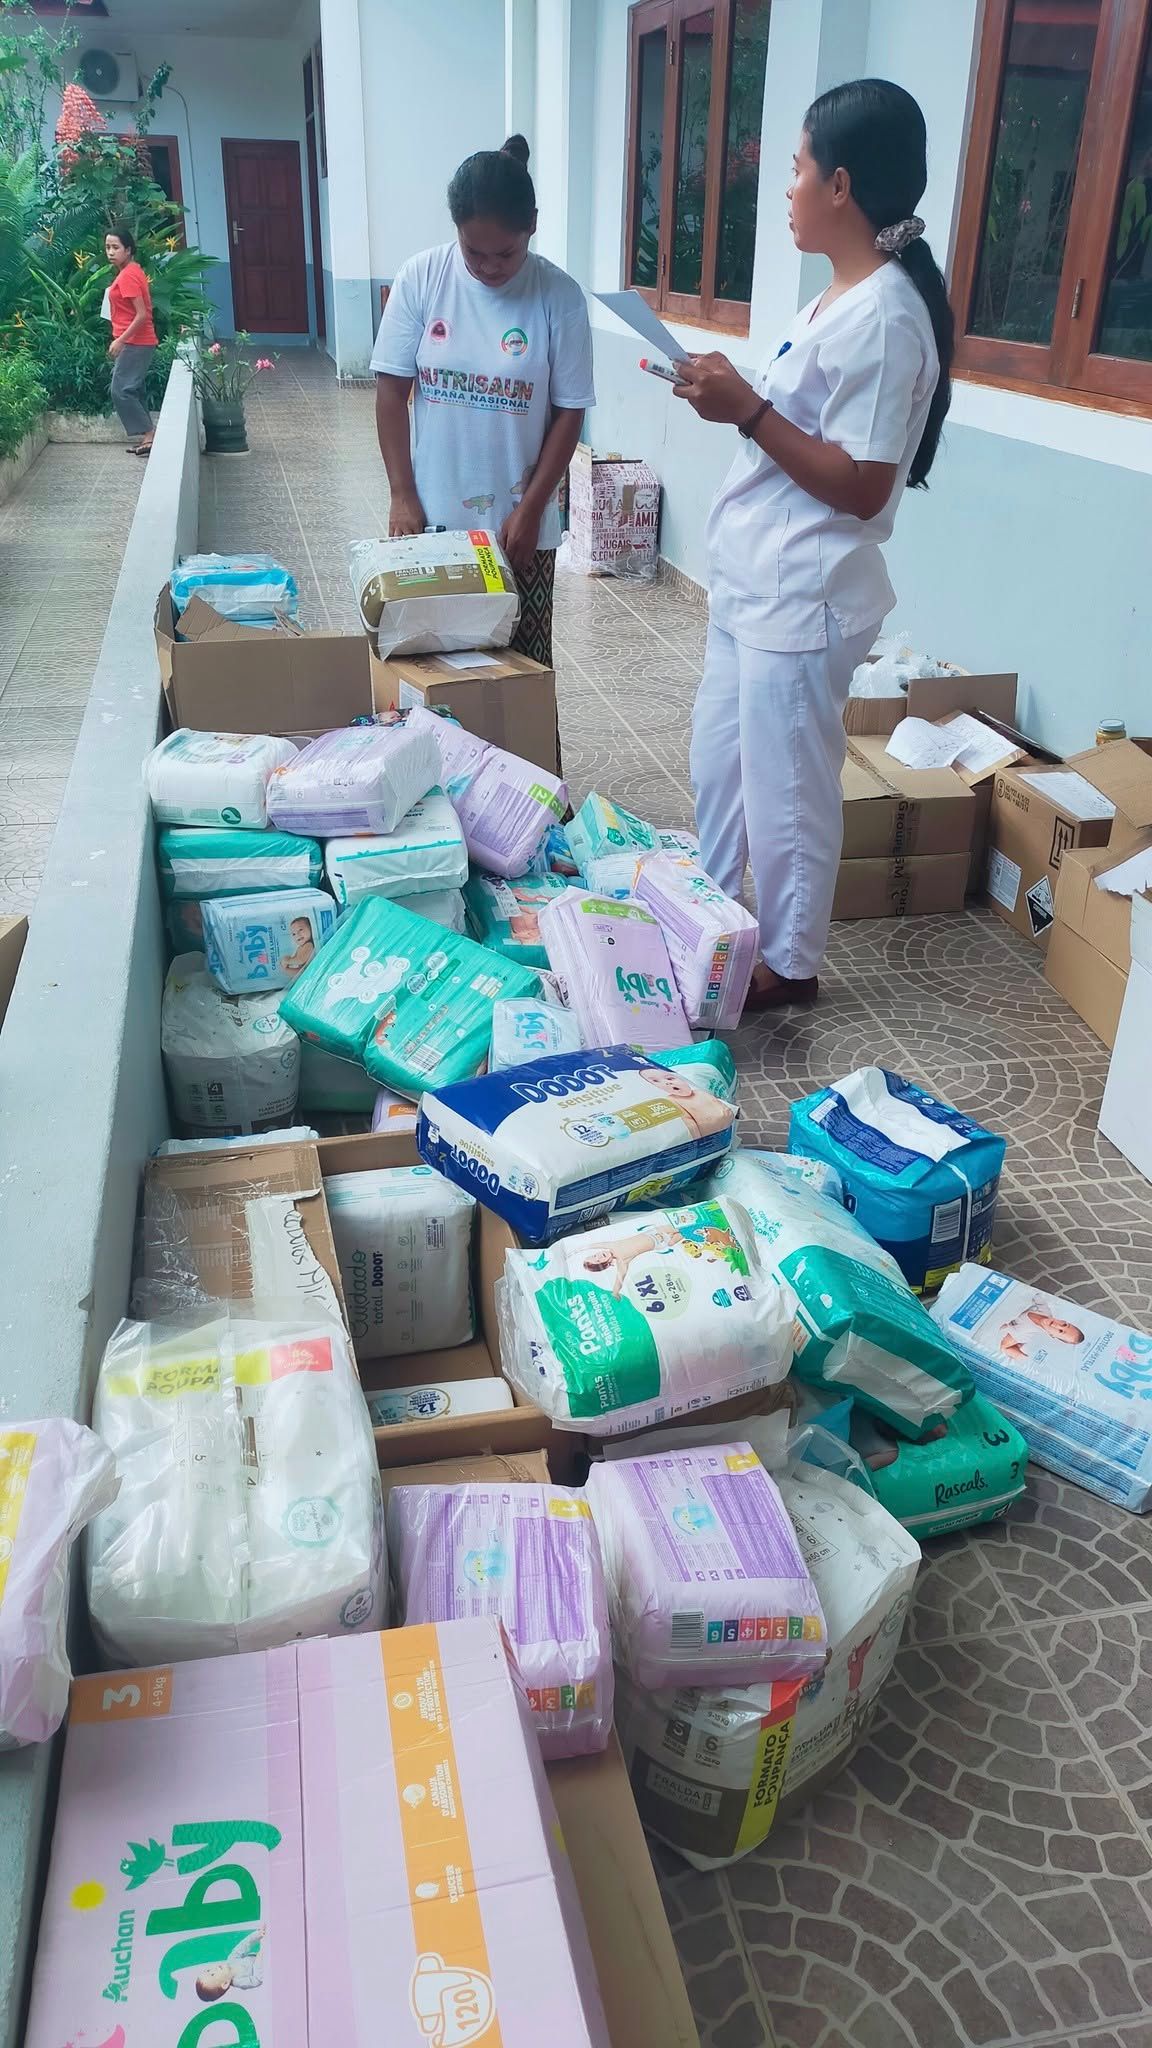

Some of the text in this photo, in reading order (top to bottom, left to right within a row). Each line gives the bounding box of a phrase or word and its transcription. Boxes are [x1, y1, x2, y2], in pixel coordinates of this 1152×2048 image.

[420, 367, 534, 400] NUTRISAUN
[616, 966, 673, 1002] baby
[510, 1063, 618, 1103] DODOT
[557, 1083, 622, 1109] sensitive
[573, 1125, 591, 1137] 12
[458, 1139, 495, 1168] sensitive
[450, 1144, 500, 1196] DODOT
[372, 1251, 384, 1287] DODOT
[567, 1295, 601, 1355] Pants
[595, 1375, 609, 1409] Pants
[418, 1402, 436, 1413] 12
[983, 1429, 1010, 1446] 3
[1010, 1461, 1019, 1479] 3
[820, 1547, 831, 1556] cm
[711, 1631, 719, 1641] 6
[727, 1629, 736, 1639] 5
[760, 1626, 768, 1637] 4
[776, 1627, 784, 1637] 3
[792, 1626, 799, 1636] 2
[102, 1684, 142, 1712] 3
[152, 1677, 167, 1707] 4-9kg
[672, 1722, 685, 1736] 5
[705, 1735, 719, 1751] 6
[753, 1734, 777, 1808] FORMATO
[763, 1721, 791, 1805] POUPANÇA
[102, 1909, 135, 2003] Auchan
[453, 1989, 481, 2030] 120
